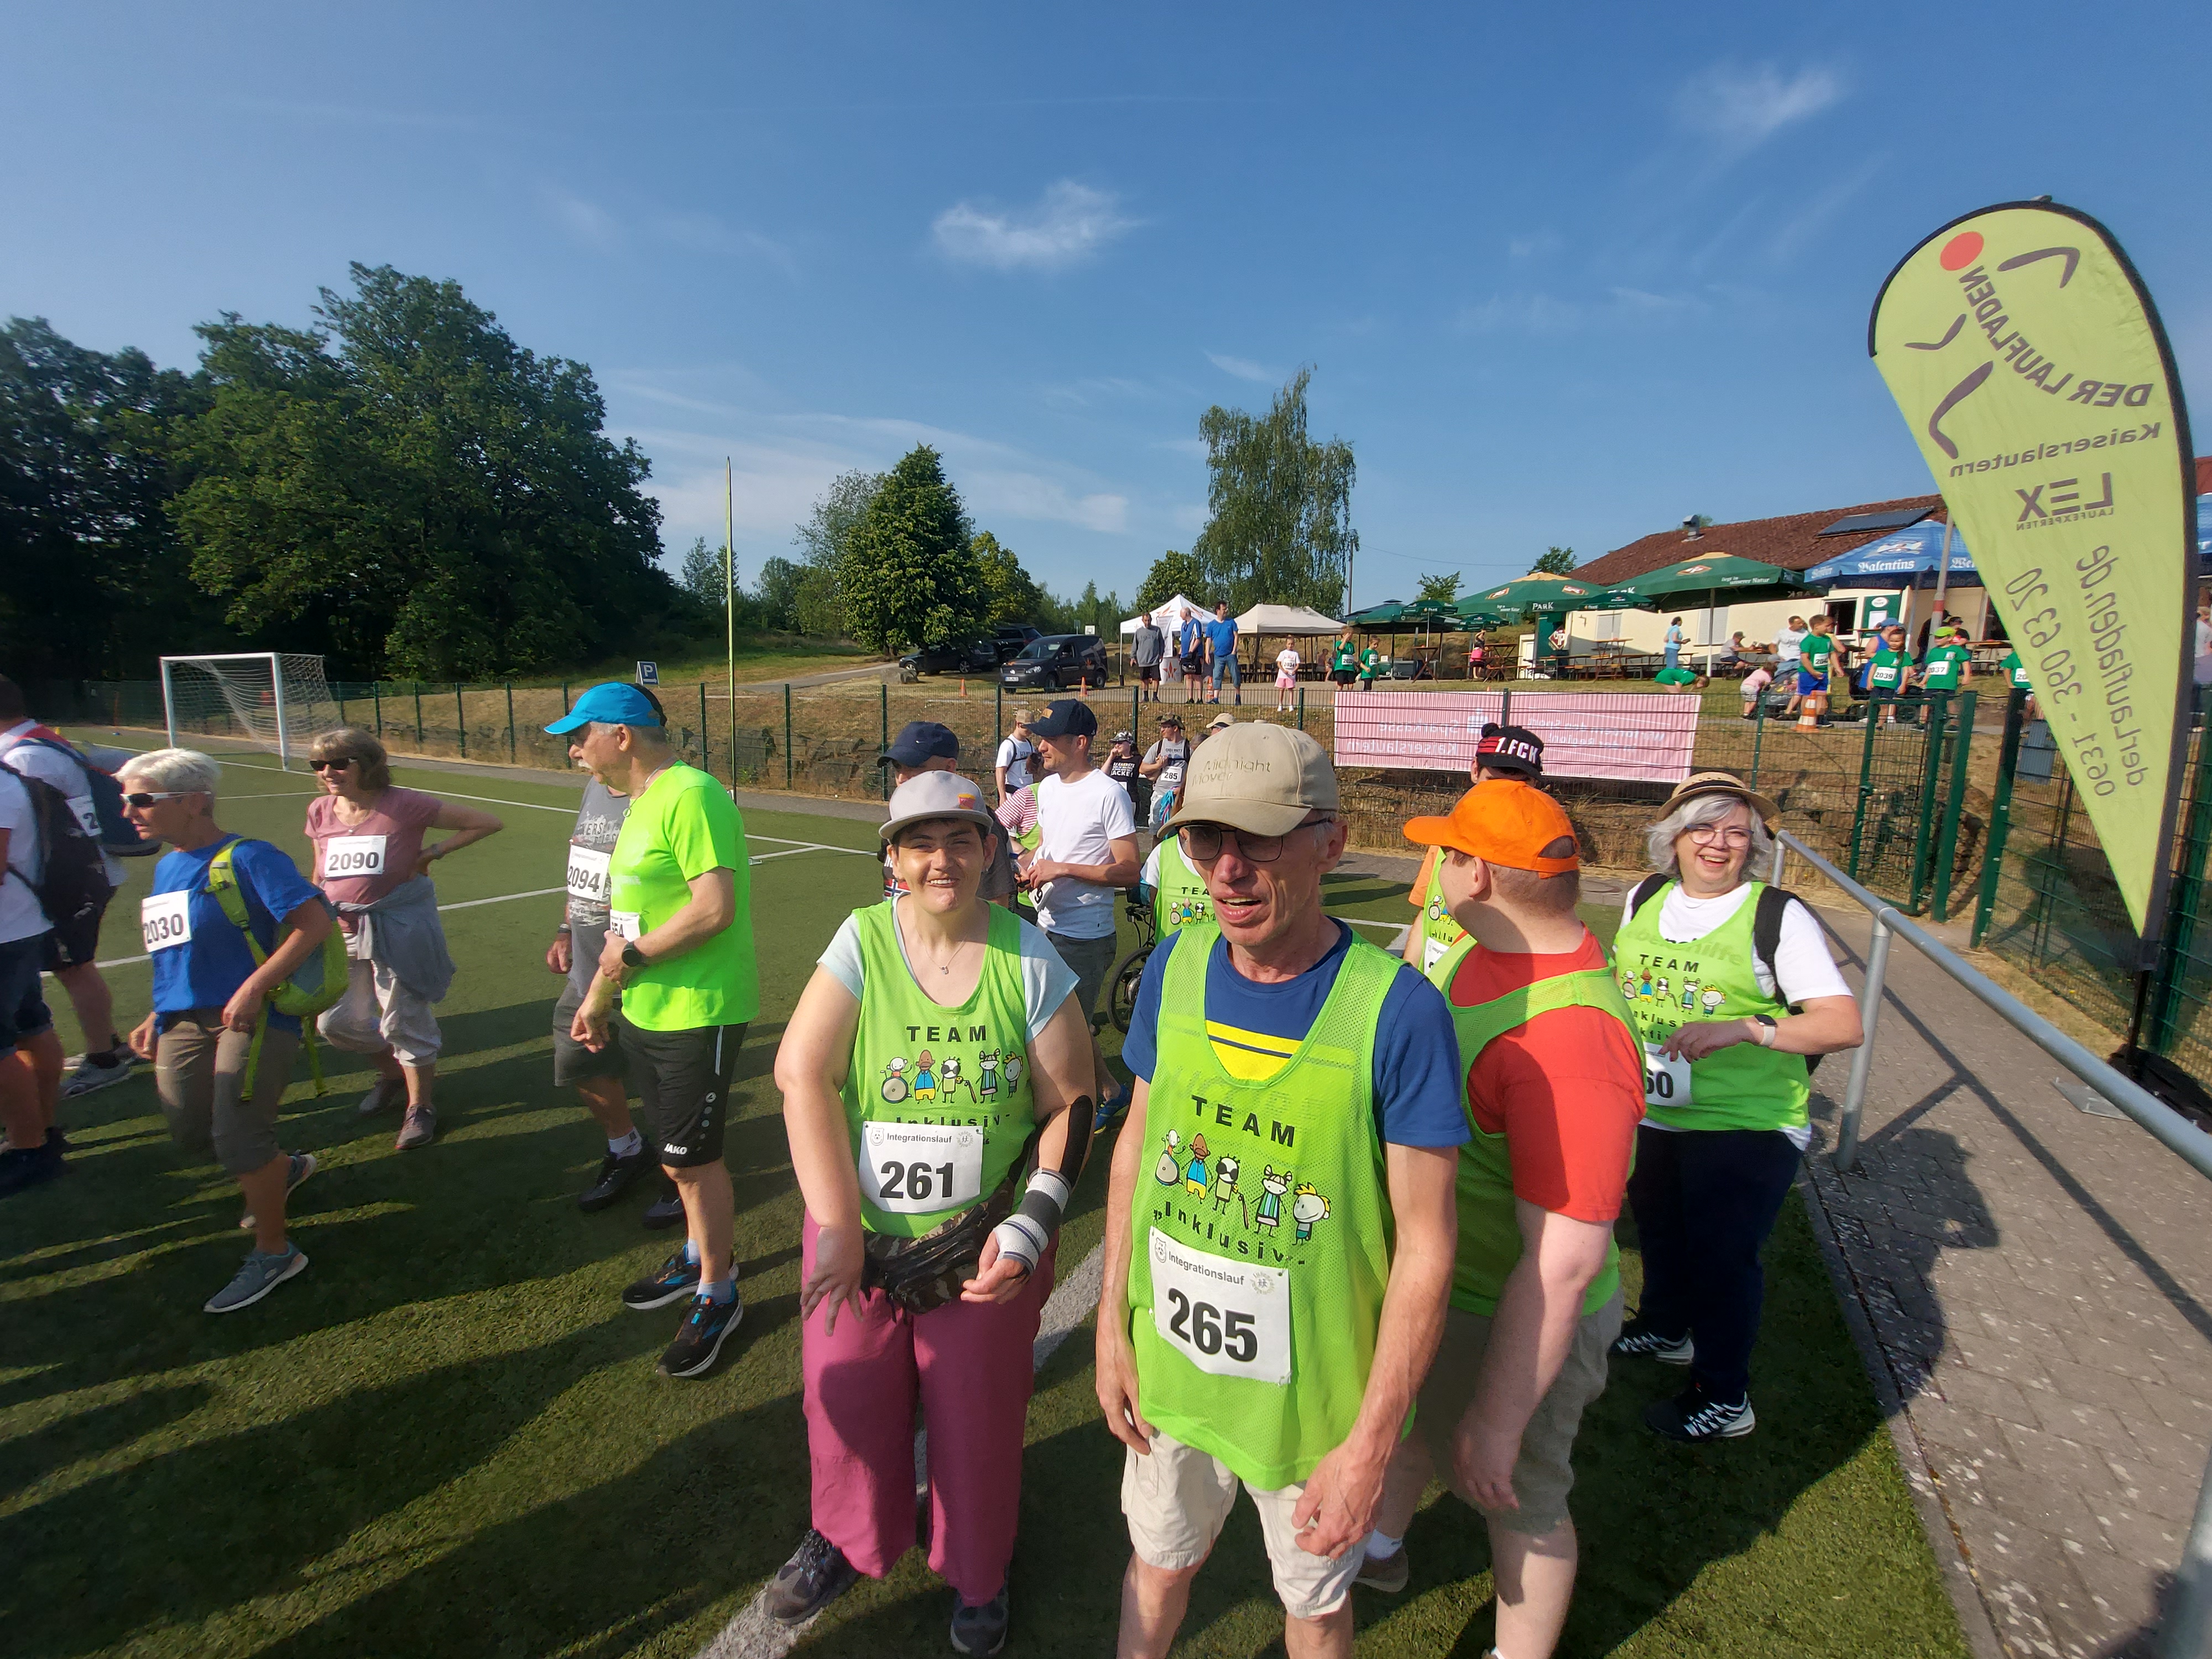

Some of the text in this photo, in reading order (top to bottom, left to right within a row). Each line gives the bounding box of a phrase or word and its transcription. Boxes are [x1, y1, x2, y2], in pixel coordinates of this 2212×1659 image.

[643, 664, 654, 677] P
[1875, 671, 1893, 680] 2039
[1203, 757, 1271, 773] Midnight
[328, 852, 379, 872] 2090
[567, 865, 601, 893] 2094
[1181, 886, 1209, 896] TEA
[143, 914, 184, 945] 2030
[1640, 953, 1699, 973] TEAM
[906, 1025, 987, 1043] TEAM
[1646, 1067, 1673, 1099] 60
[1191, 1094, 1295, 1148] TEAM
[887, 1133, 952, 1144] Integrationslauf
[664, 1143, 687, 1155] JAKO
[879, 1161, 954, 1200] 261
[1168, 1250, 1245, 1286] Integrationslauf
[1167, 1287, 1258, 1362] 265
